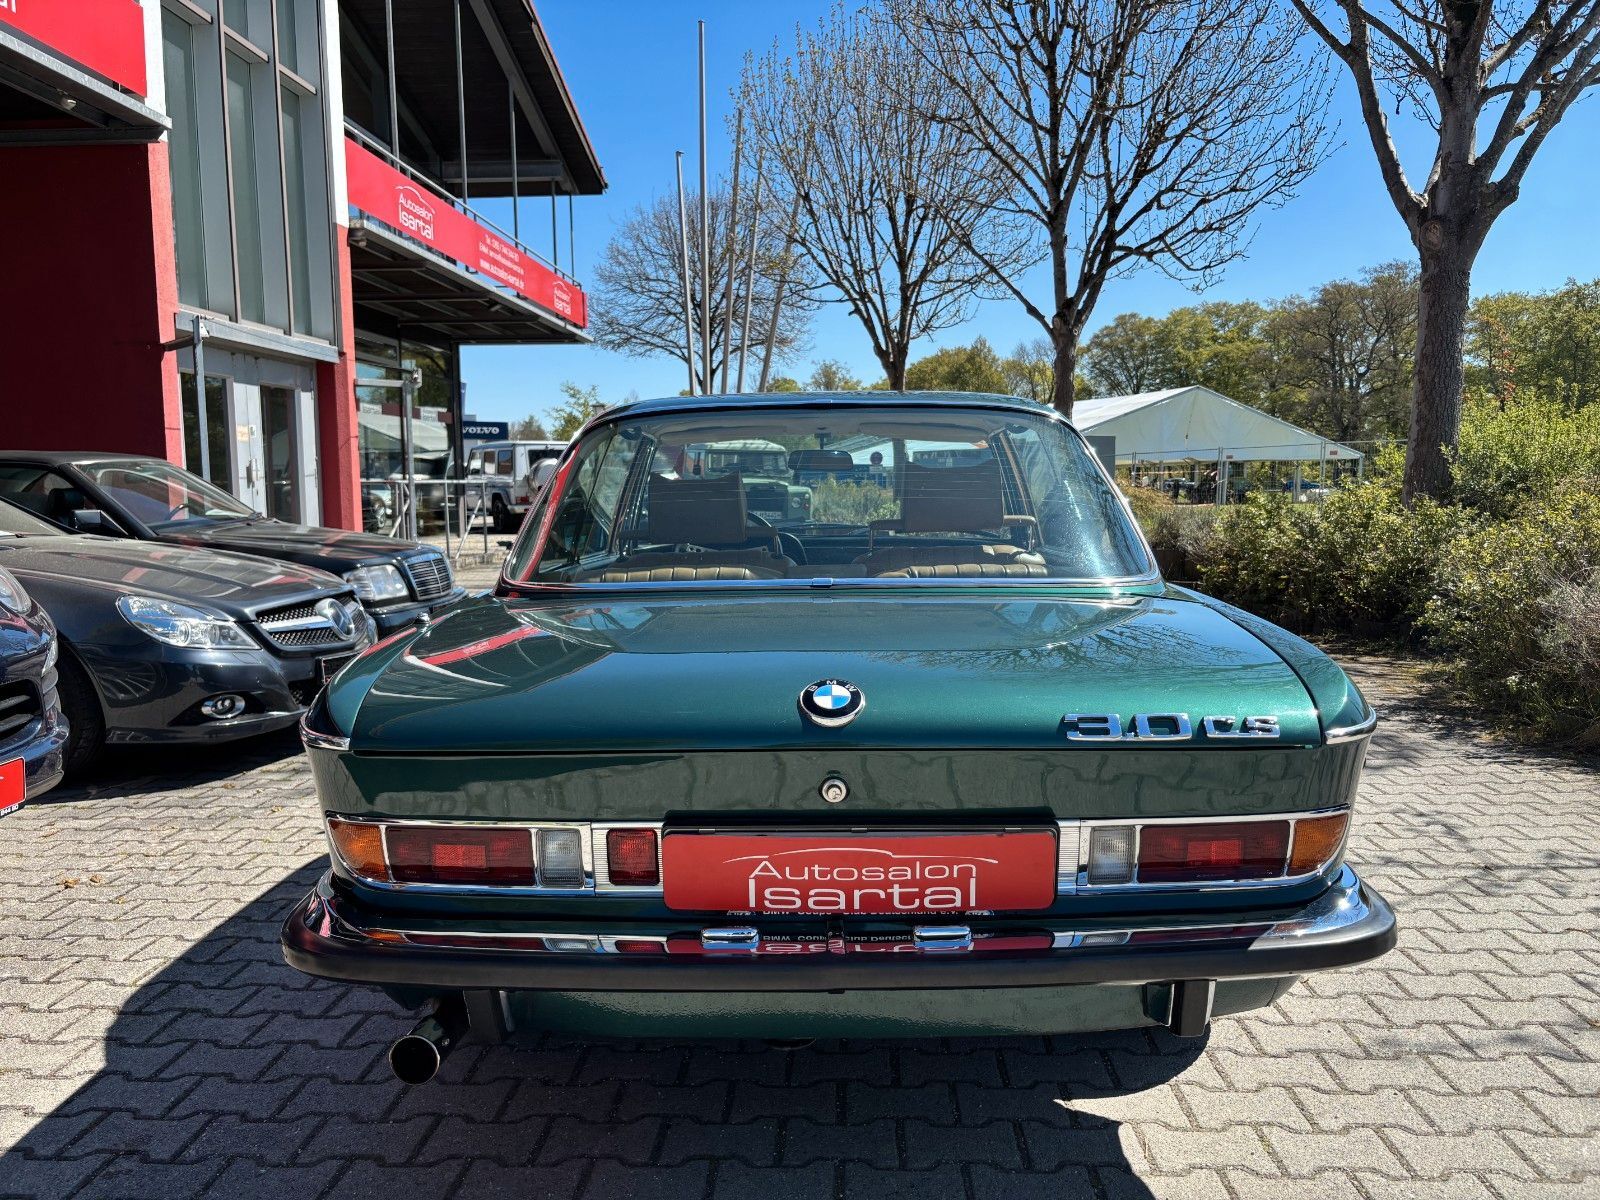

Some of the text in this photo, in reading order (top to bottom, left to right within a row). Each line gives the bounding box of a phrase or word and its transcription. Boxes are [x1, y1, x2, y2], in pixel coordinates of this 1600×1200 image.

[399, 192, 433, 221] Autosalon
[399, 203, 433, 240] Isartal
[463, 426, 500, 435] VOLVO
[807, 680, 857, 692] BMW
[1063, 713, 1192, 741] 3.0
[750, 860, 976, 881] Autosalon
[749, 878, 976, 910] Isartal
